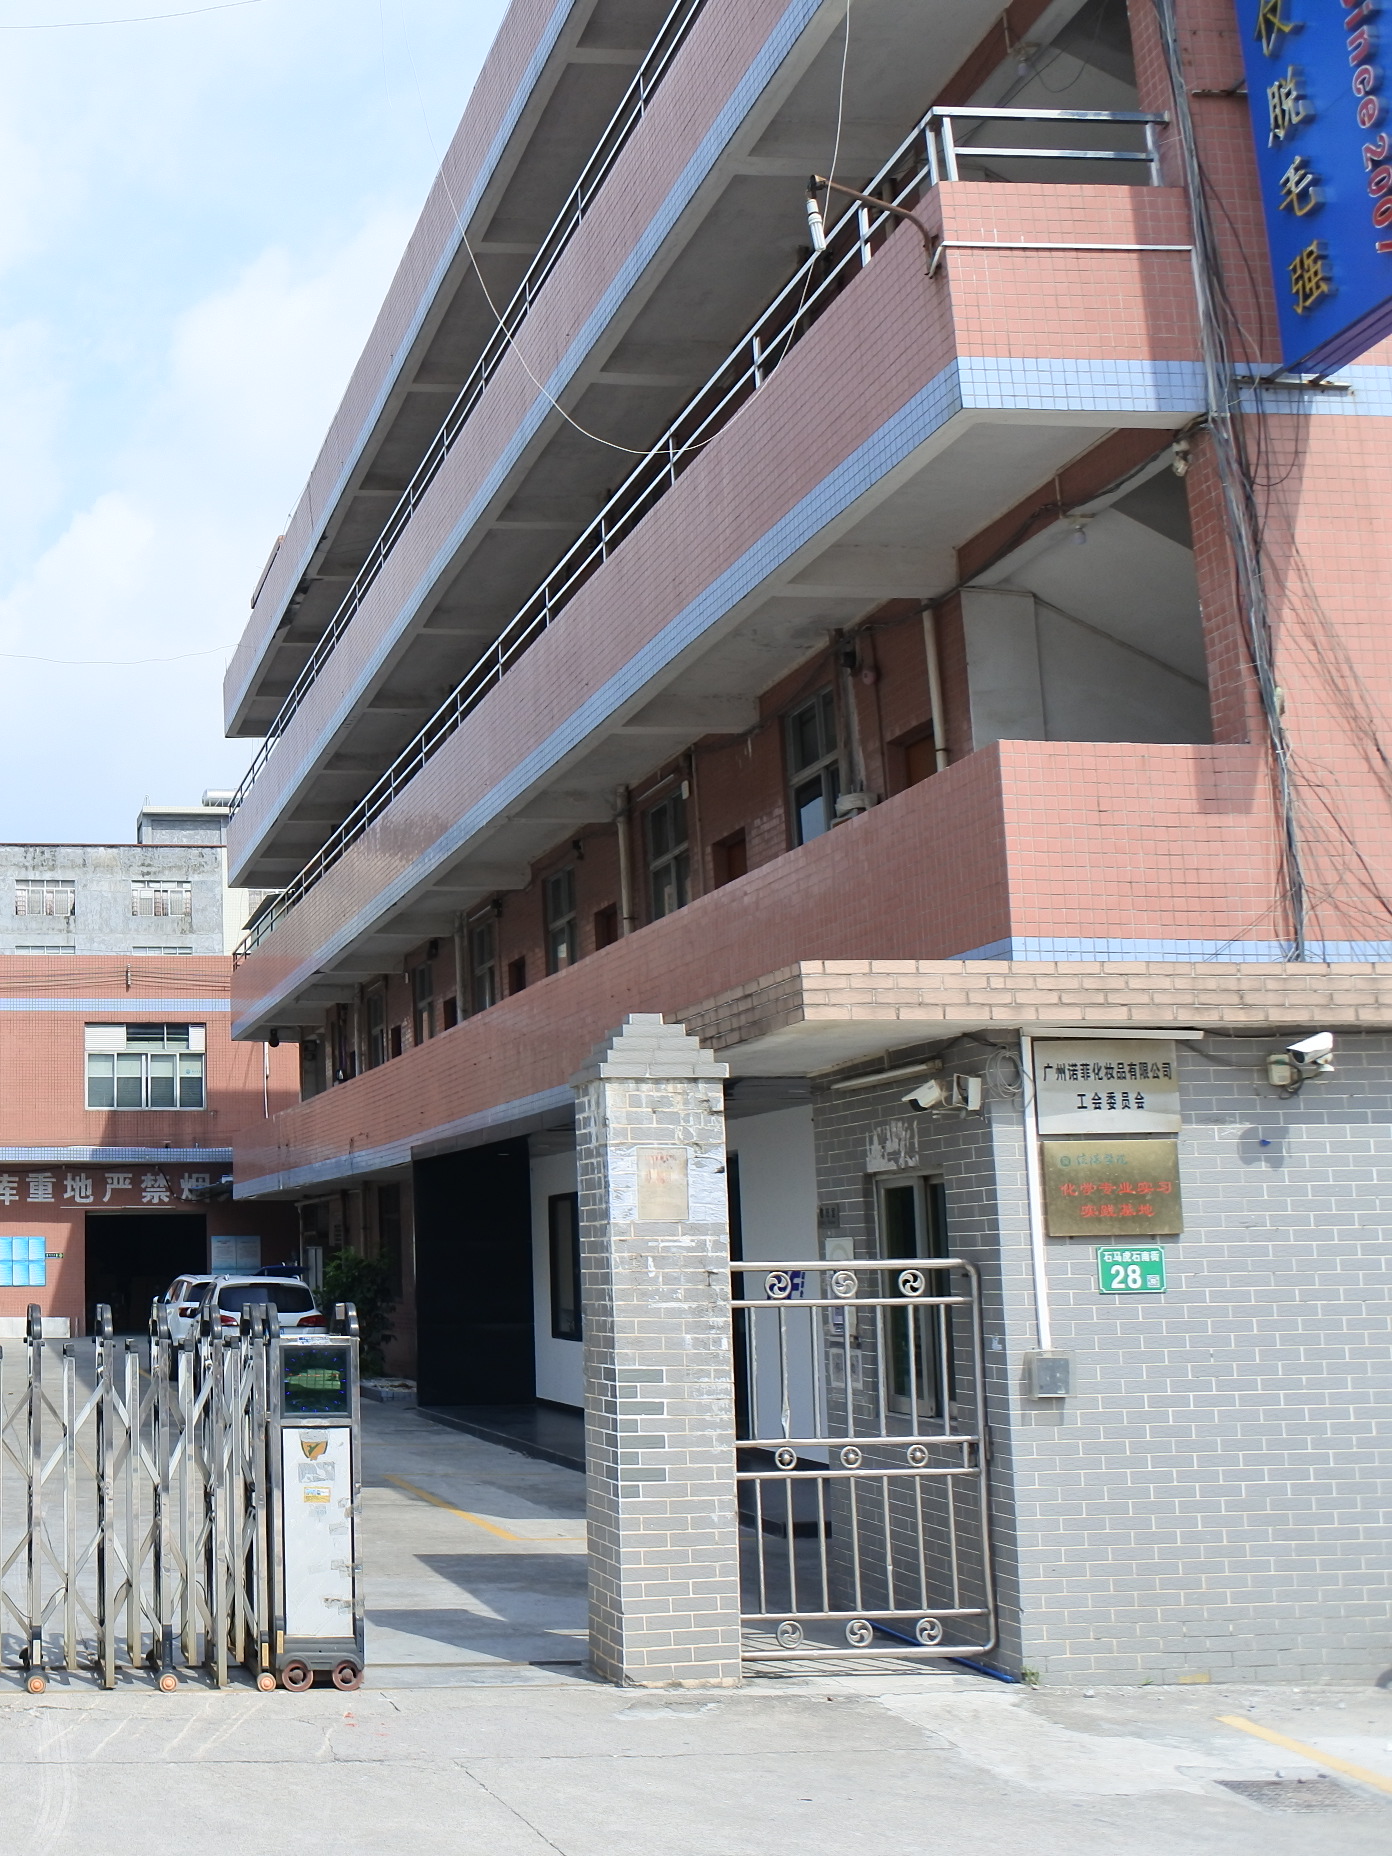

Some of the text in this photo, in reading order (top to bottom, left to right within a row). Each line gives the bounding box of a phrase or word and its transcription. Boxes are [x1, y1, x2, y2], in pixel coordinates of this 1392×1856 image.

[1340, 0, 1379, 129] ince
[1042, 1061, 1173, 1081] 广州诺菲化妆品有限公司
[1076, 1090, 1145, 1110] 工会委员会
[1059, 1181, 1173, 1197] 化学专业实习
[1080, 1204, 1156, 1218] 实践基地
[1110, 1264, 1142, 1289] 28
